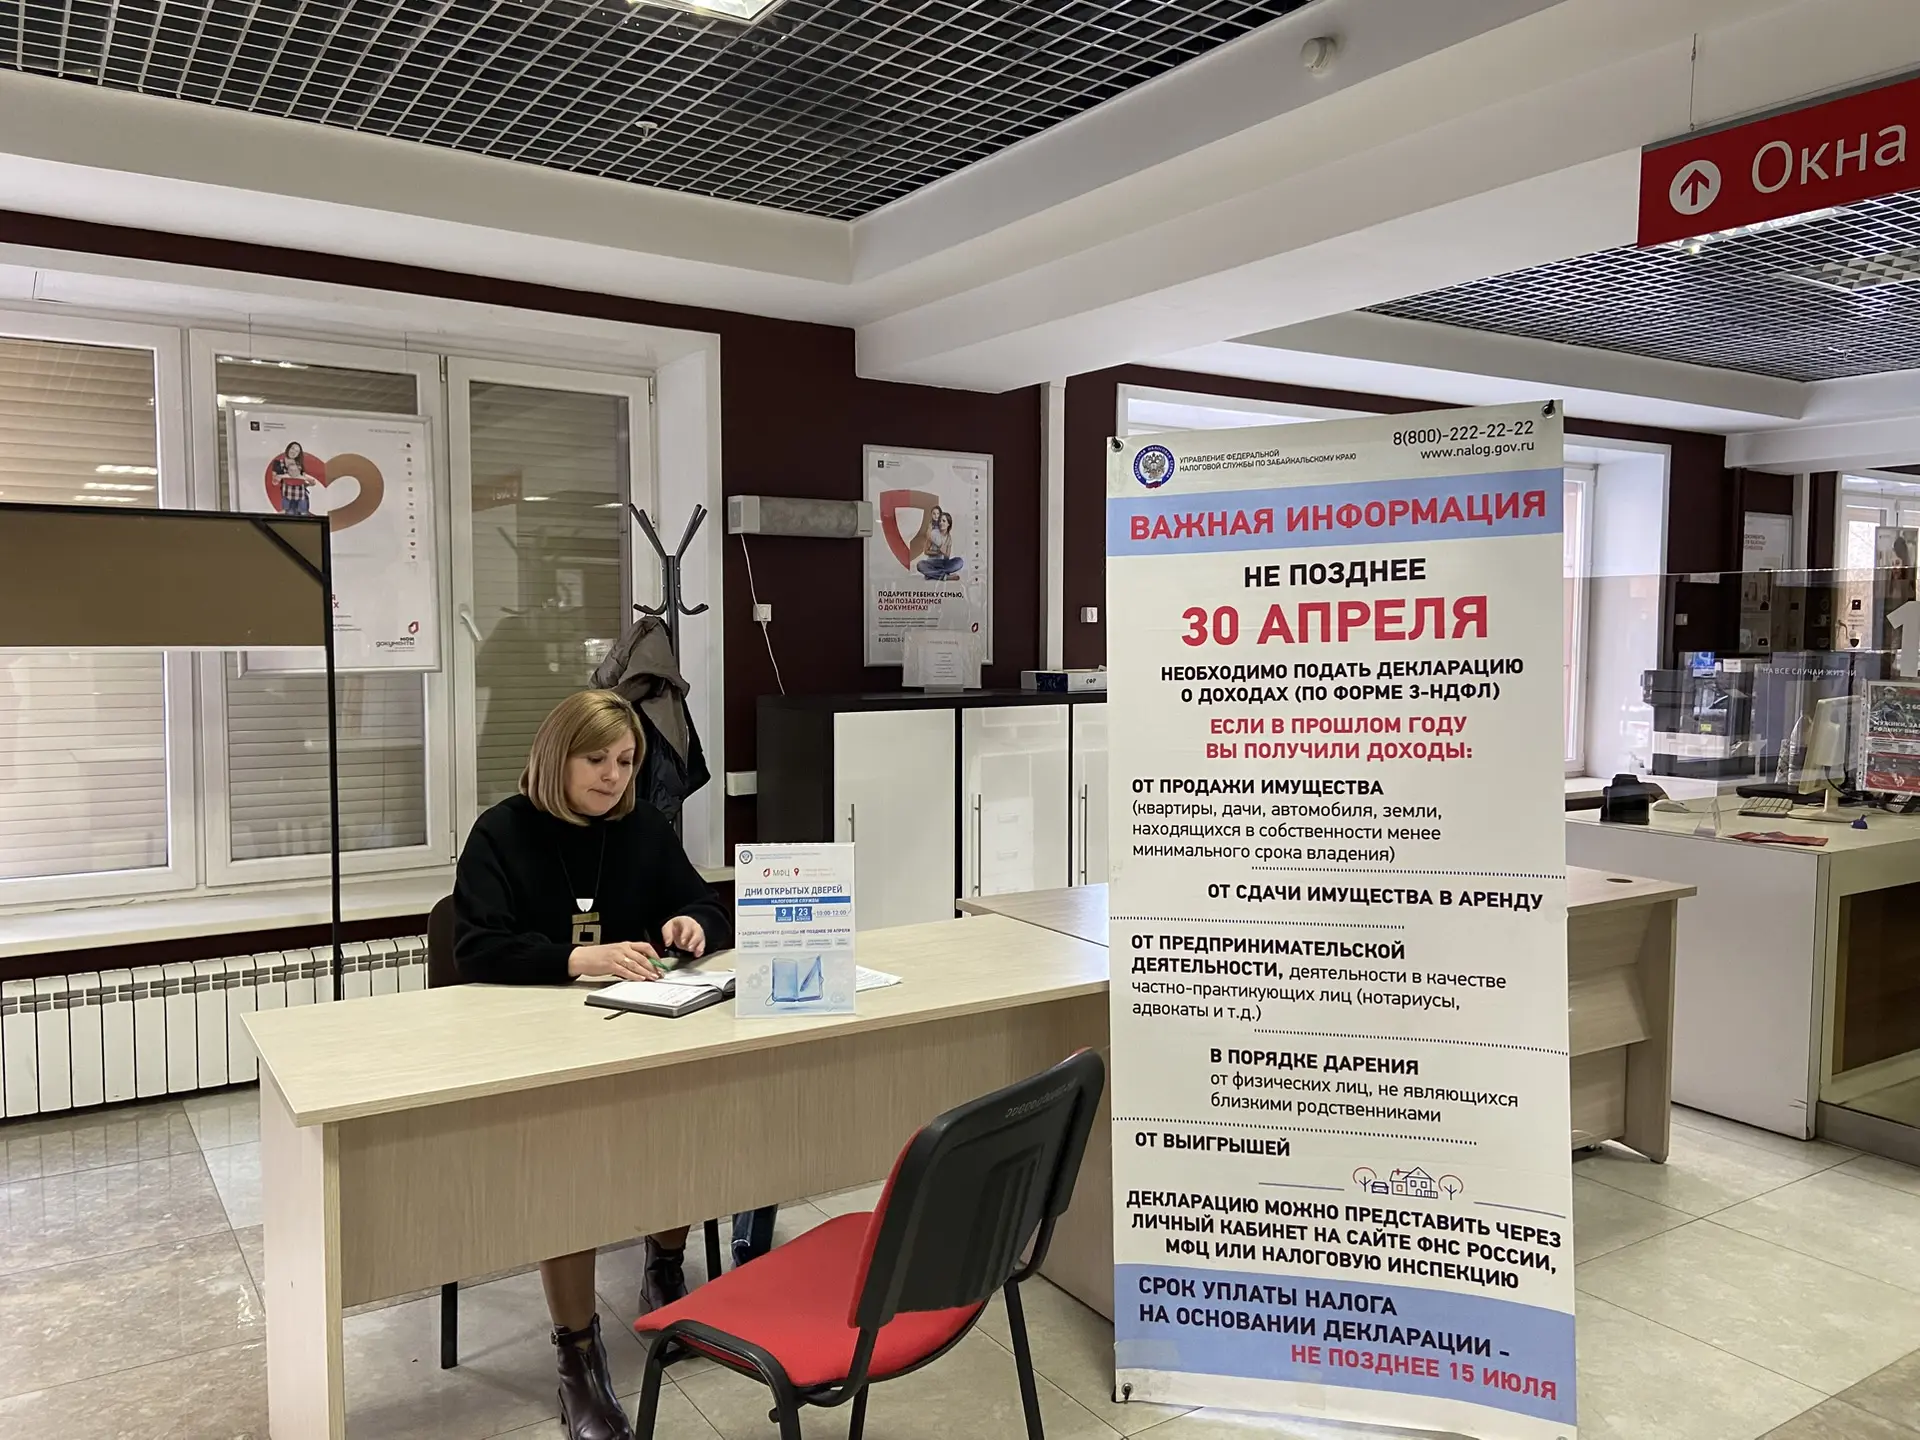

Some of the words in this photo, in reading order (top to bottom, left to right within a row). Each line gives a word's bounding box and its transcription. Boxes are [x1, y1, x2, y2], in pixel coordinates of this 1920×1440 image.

[1752, 125, 1906, 193] Окна
[1393, 420, 1533, 446] 8(800)-222-22-22
[1180, 453, 1224, 463] УПРАВЛЕНИЕ
[1226, 449, 1279, 461] ФЕДЕРАЛЬНОЙ
[1421, 440, 1534, 459] www.nalog.gov.ru
[1180, 462, 1222, 471] НАЛОГОВОЙ
[1223, 460, 1255, 469] СЛУЖБЫ
[1267, 455, 1334, 466] ЗАБАЙКАЛЬСКОМУ
[1130, 509, 1274, 540] ВАЖНАЯ
[1287, 490, 1546, 533] ИНФОРМАЦИЯ
[1245, 566, 1280, 587] НЕ
[1290, 558, 1425, 587] ПОЗДНЕЕ
[1182, 606, 1238, 646] 30
[1257, 596, 1487, 644] АПРЕЛЯ
[1162, 665, 1287, 682] НЕОБХОДИМО
[1295, 663, 1371, 681] ПОДАТЬ
[1377, 659, 1523, 679] ДЕКЛАРАЦИЮ
[1182, 689, 1192, 702] О
[1198, 687, 1288, 705] ДОХОДАХ
[1295, 686, 1327, 703] (ПО
[1334, 685, 1402, 700] ФОРМЕ
[1410, 682, 1499, 701] 3-НДФЛ)
[1211, 719, 1263, 734] ЕСЛИ
[1272, 719, 1284, 733] В
[1292, 717, 1400, 733] ПРОШЛОМ
[1409, 717, 1466, 736] ГОДУ
[1207, 743, 1236, 758] ВЫ
[1245, 743, 1359, 758] ПОЛУЧИЛИ
[1367, 742, 1472, 762] ДОХОДЫ:
[1133, 779, 1154, 793] ОТ
[1160, 779, 1254, 796] ПРОДАЖИ
[1262, 780, 1383, 797] ИМУЩЕСТВА
[1133, 800, 1216, 818] (квартиры,
[1222, 805, 1265, 817] дачи,
[1272, 802, 1377, 819] автомобиля,
[1383, 807, 1441, 820] земли,
[1133, 825, 1240, 838] находящихся
[1246, 826, 1254, 836] в
[1259, 823, 1382, 839] собственности
[1388, 829, 1440, 840] менее
[1134, 846, 1250, 858] минимального
[1255, 848, 1301, 862] срока
[1307, 846, 1394, 863] владения)
[745, 888, 762, 897] ДНИ
[765, 886, 809, 895] ОТКРЫТЫХ
[811, 885, 842, 895] ДВЕРЕЙ
[1208, 884, 1230, 898] ОТ
[1237, 885, 1300, 902] СДАЧИ
[1308, 887, 1433, 906] ИМУЩЕСТВА
[1440, 891, 1452, 905] В
[1459, 891, 1543, 912] АРЕНДУ
[798, 908, 808, 916] 23
[1132, 935, 1153, 949] ОТ
[1159, 935, 1405, 960] ПРЕДПРИНИМАТЕЛЬСКОЙ
[1132, 957, 1283, 979] ДЕЯТЕЛЬНОСТИ,
[1289, 967, 1406, 982] деятельности
[1413, 973, 1421, 983] в
[1427, 973, 1506, 988] качестве
[1132, 982, 1314, 1002] частно-практикующих
[1320, 991, 1352, 1005] лиц
[1357, 989, 1460, 1010] (нотариусы,
[1133, 1004, 1208, 1016] адвокаты
[1214, 1007, 1222, 1017] и
[1228, 1005, 1261, 1021] т.д.)
[1211, 1049, 1221, 1062] В
[1229, 1049, 1317, 1070] ПОРЯДКЕ
[1324, 1055, 1418, 1075] ДАРЕНИЯ
[1211, 1074, 1228, 1085] от
[1233, 1071, 1330, 1092] физических
[1336, 1082, 1372, 1097] лиц,
[1379, 1085, 1398, 1096] не
[1404, 1087, 1517, 1107] являющихся
[1211, 1092, 1291, 1111] близкими
[1298, 1102, 1440, 1122] родственниками
[1136, 1132, 1157, 1147] ОТ
[1164, 1133, 1289, 1156] ВЫИГРЫШЕЙ
[1127, 1191, 1258, 1214] ДЕКЛАРАЦИЮ
[1265, 1200, 1338, 1219] МОЖНО
[1345, 1206, 1490, 1236] ПРЕДСТАВИТЬ
[1496, 1222, 1560, 1247] ЧЕРЕЗ
[1132, 1214, 1213, 1233] ЛИЧНЫЙ
[1221, 1219, 1308, 1240] КАБИНЕТ
[1315, 1227, 1341, 1243] НА
[1347, 1228, 1411, 1250] САЙТЕ
[1418, 1237, 1460, 1255] ФНС
[1467, 1241, 1556, 1275] РОССИИ,
[1166, 1238, 1209, 1259] МФЦ
[1216, 1242, 1255, 1259] ИЛИ
[1263, 1246, 1381, 1270] НАЛОГОВУЮ
[1388, 1256, 1519, 1289] ИНСПЕКЦИЮ
[1139, 1276, 1195, 1297] СРОК
[1203, 1281, 1296, 1305] УПЛАТЫ
[1306, 1290, 1397, 1315] НАЛОГА
[1140, 1304, 1170, 1323] НА
[1177, 1308, 1315, 1335] ОСНОВАНИИ
[1324, 1319, 1490, 1358] ДЕКЛАРАЦИИ
[1292, 1345, 1321, 1364] НЕ
[1329, 1348, 1439, 1377] ПОЗДНЕЕ
[1450, 1363, 1474, 1382] 15
[1484, 1368, 1556, 1400] ИЮЛЯ
